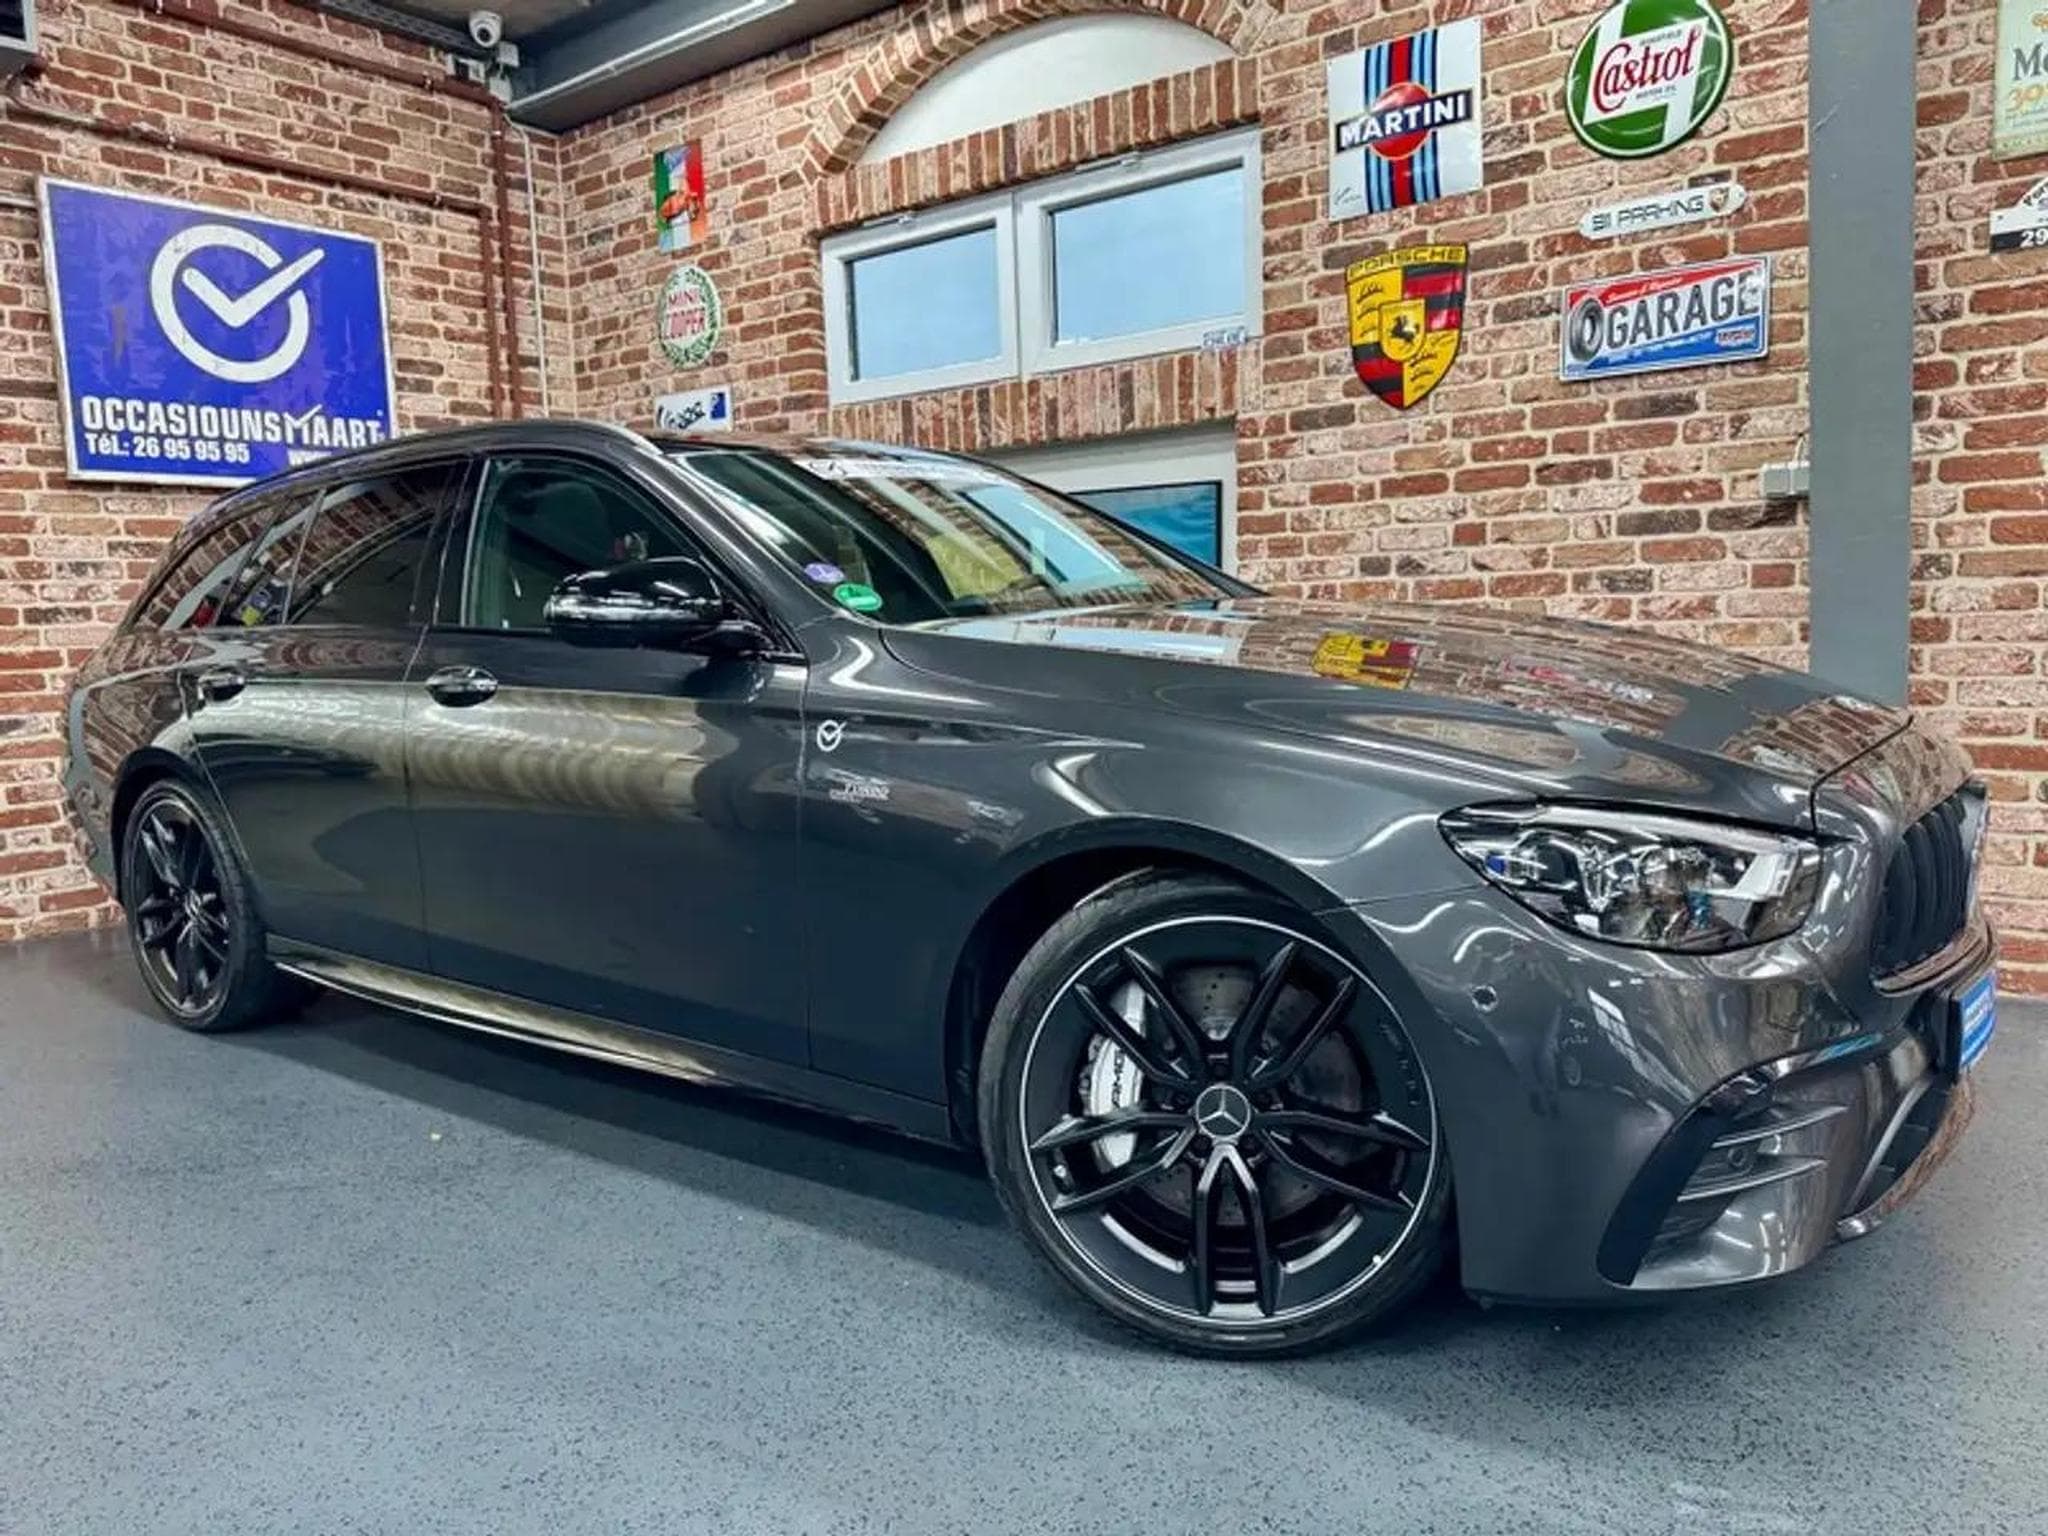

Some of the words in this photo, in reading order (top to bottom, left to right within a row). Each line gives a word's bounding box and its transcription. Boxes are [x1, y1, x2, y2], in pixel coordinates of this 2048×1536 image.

[1593, 25, 1701, 113] Castrol
[1340, 93, 1466, 147] MARTINI
[1618, 195, 1704, 229] PARKING
[1347, 246, 1464, 279] PORSCHE
[1606, 269, 1760, 350] GARAGE
[81, 395, 381, 449] OCCASIOUNSMAART
[133, 435, 160, 459] 26
[163, 437, 191, 461] 95
[195, 439, 221, 462] 95
[223, 441, 250, 465] 95
